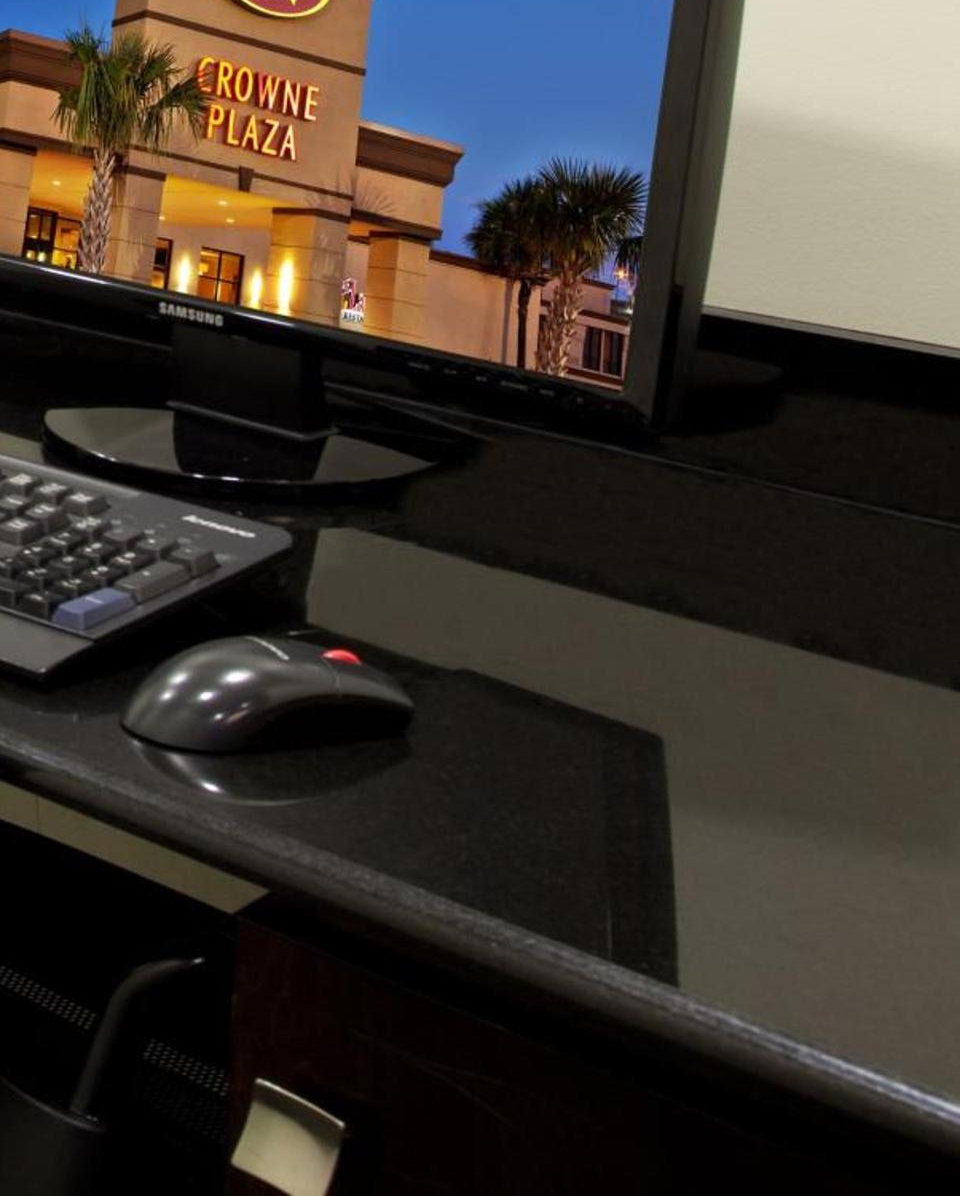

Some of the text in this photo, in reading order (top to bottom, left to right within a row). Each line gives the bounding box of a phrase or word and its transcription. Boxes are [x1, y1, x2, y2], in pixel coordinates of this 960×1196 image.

[197, 57, 320, 121] CROWNE
[207, 104, 296, 161] PLAZA
[159, 301, 224, 327] SAMSUNG
